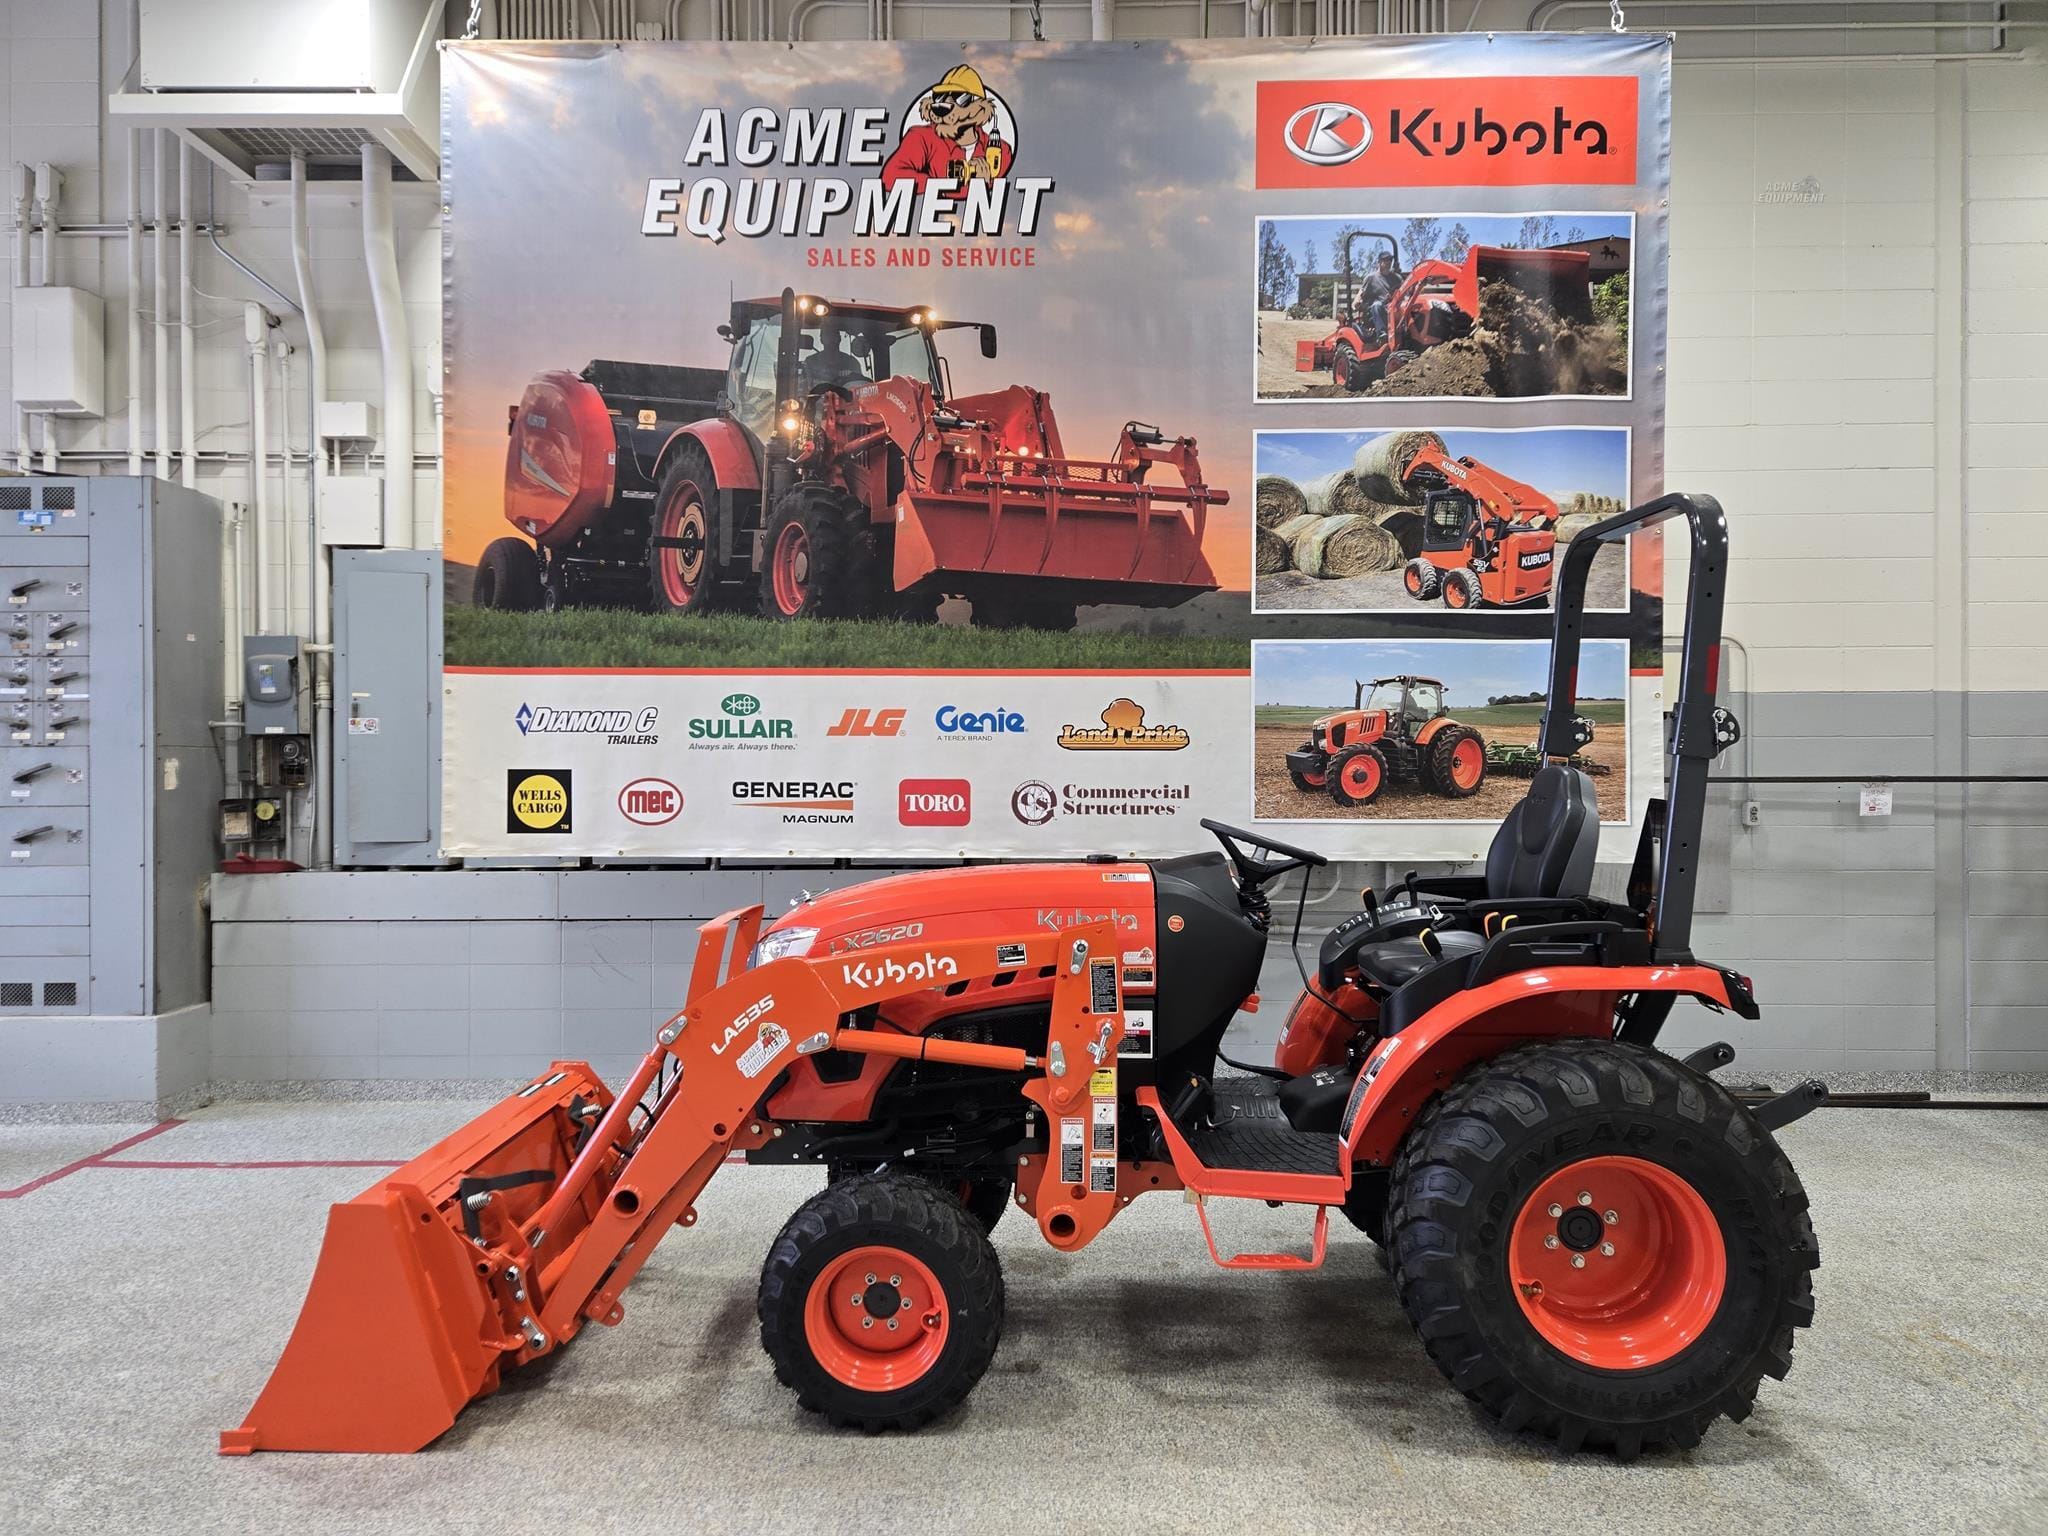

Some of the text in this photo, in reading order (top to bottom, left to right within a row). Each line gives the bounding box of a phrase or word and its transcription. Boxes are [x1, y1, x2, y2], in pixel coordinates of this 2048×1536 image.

[683, 106, 889, 167] ACME
[1390, 106, 1609, 157] Kubota
[641, 177, 1055, 244] EQUIPMENT
[807, 247, 1036, 267] SALES AND SERVICE
[1441, 460, 1467, 480] KUBOTA
[1521, 552, 1551, 567] KUBOTA
[635, 706, 658, 733] C
[688, 718, 793, 739] SULLAIR
[826, 708, 907, 737] JLG
[935, 705, 1025, 733] Genie
[607, 735, 659, 745] TRAILERS
[1062, 725, 1188, 743] Land Pride
[688, 743, 796, 752] Always air. Always there.
[518, 789, 561, 801] WELLS
[732, 781, 854, 798] GENERAC
[1062, 783, 1190, 799] Commercial
[517, 802, 563, 814] CARGO
[905, 793, 964, 813] TORO
[1062, 800, 1176, 815] Structures
[782, 815, 854, 824] MAGNUM
[830, 922, 924, 956] LX2620
[842, 952, 958, 988] Kubota
[711, 994, 775, 1055] LA535
